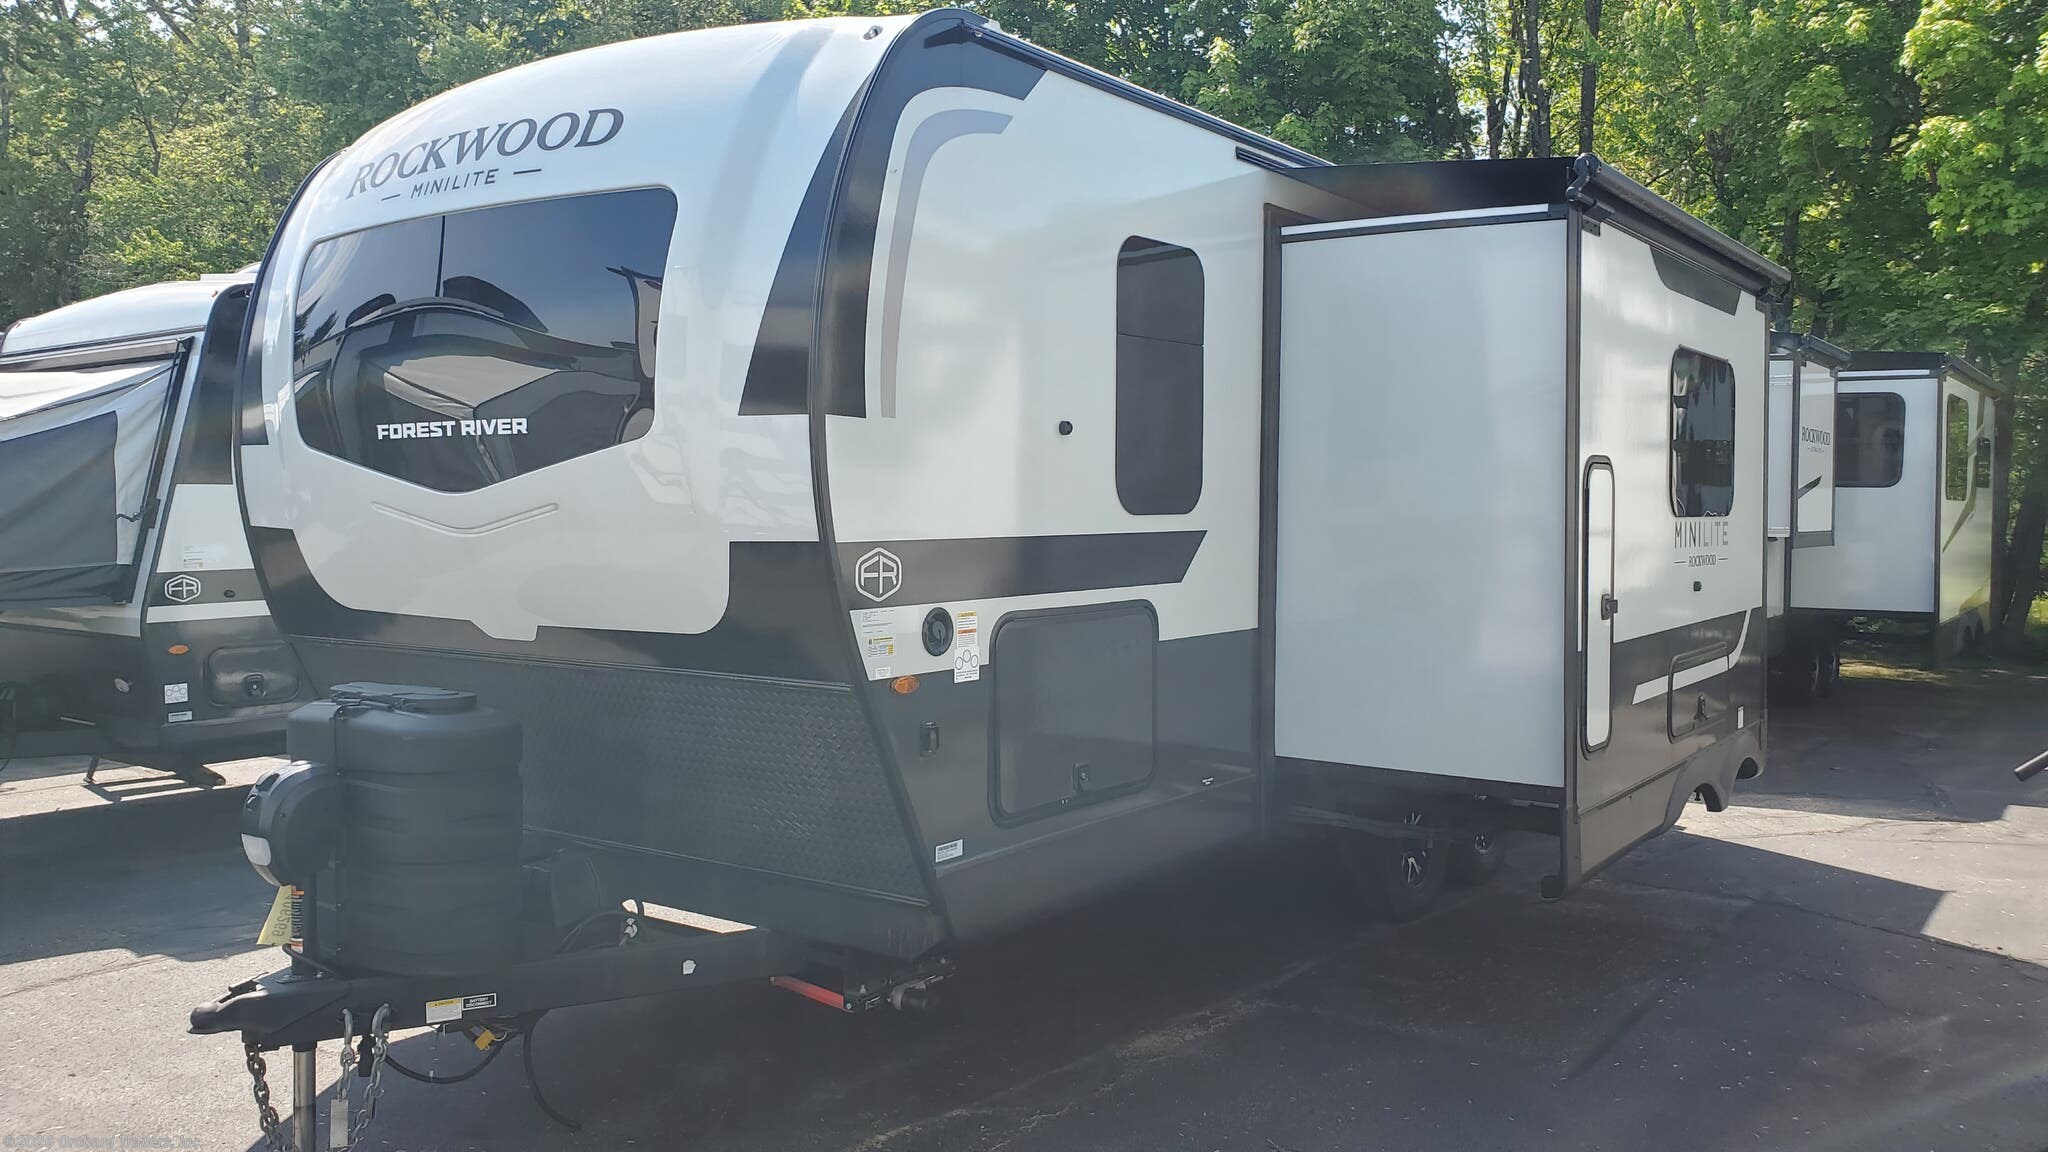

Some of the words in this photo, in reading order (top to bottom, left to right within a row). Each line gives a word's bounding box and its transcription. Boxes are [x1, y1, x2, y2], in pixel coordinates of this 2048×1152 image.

[345, 108, 625, 200] ROCKWOOD
[410, 168, 499, 199] MINILITE
[375, 420, 456, 440] FOREST
[460, 417, 529, 436] RIVER
[1674, 520, 1729, 549] MINILITE
[1688, 554, 1717, 567] ROCKWOOD
